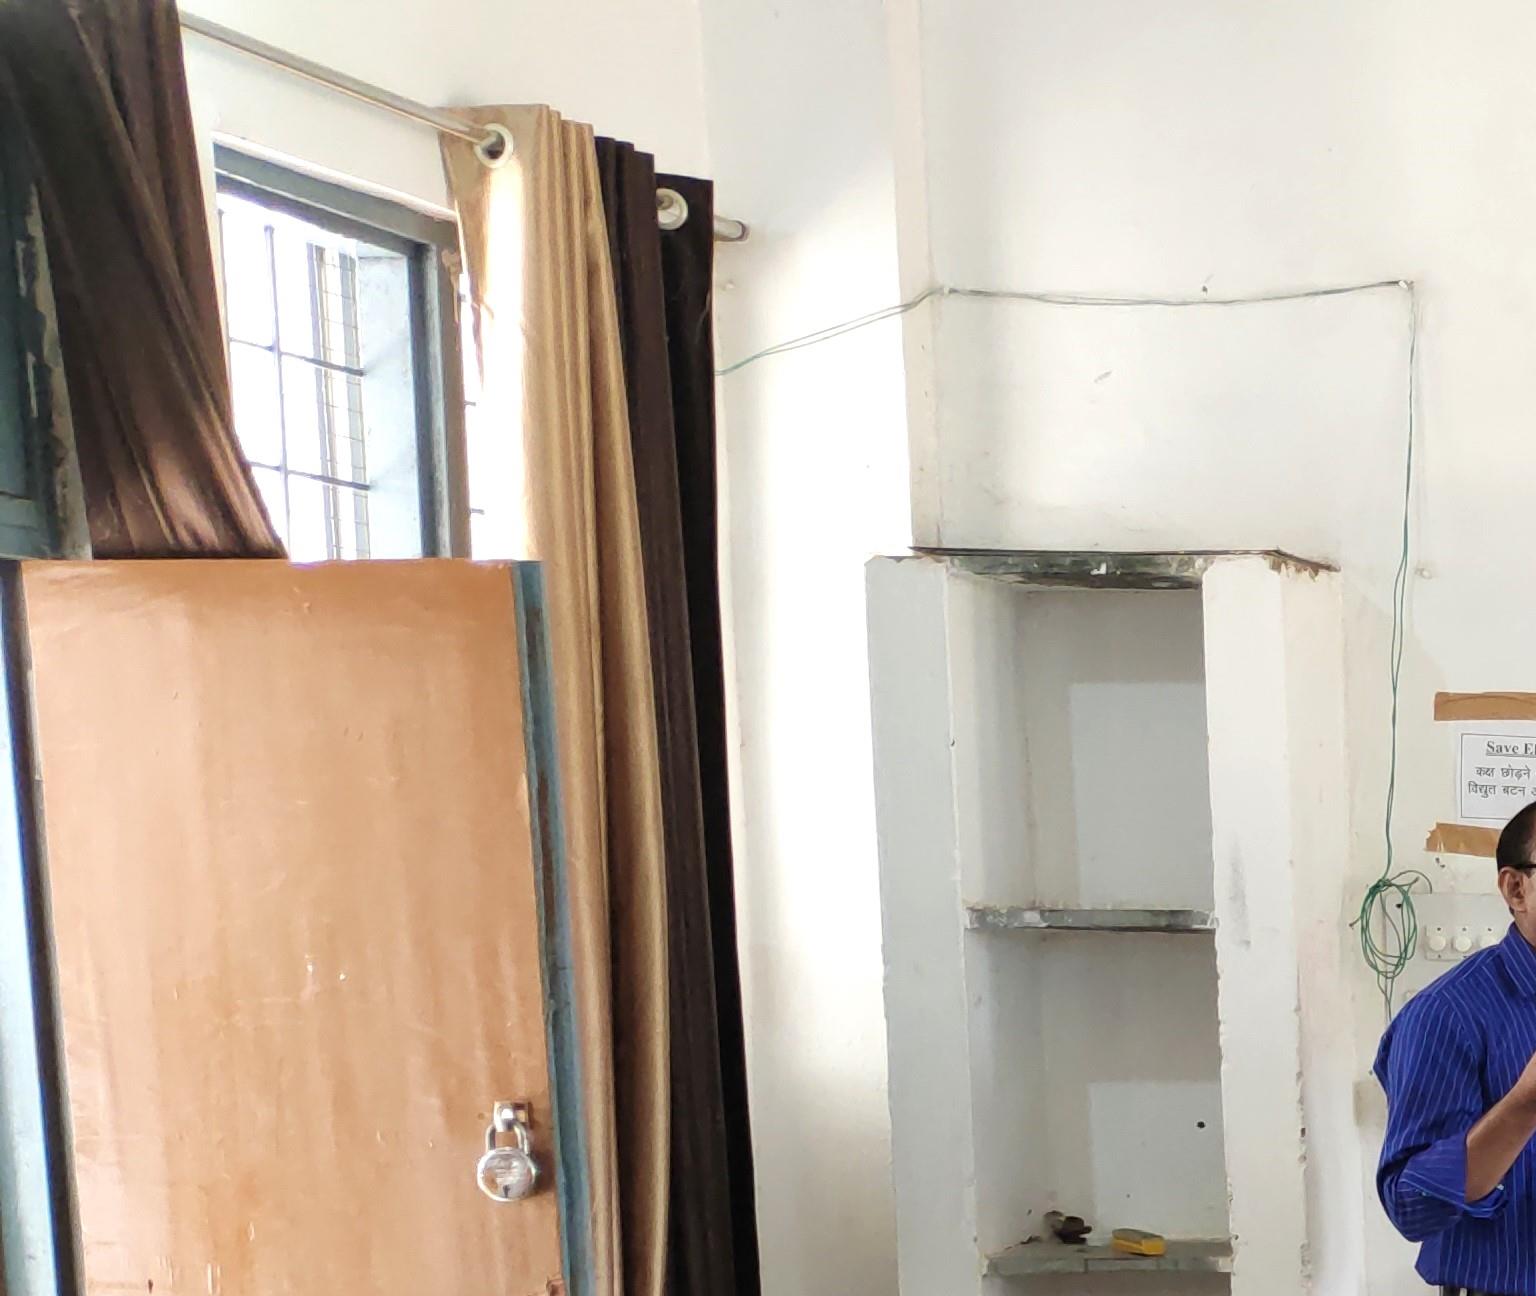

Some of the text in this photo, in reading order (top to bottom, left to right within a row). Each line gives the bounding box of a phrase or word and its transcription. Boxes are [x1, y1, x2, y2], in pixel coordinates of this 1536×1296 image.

[1486, 740, 1519, 757] Save
[1467, 780, 1497, 799] विद्युत
[1501, 784, 1526, 798] बटन
